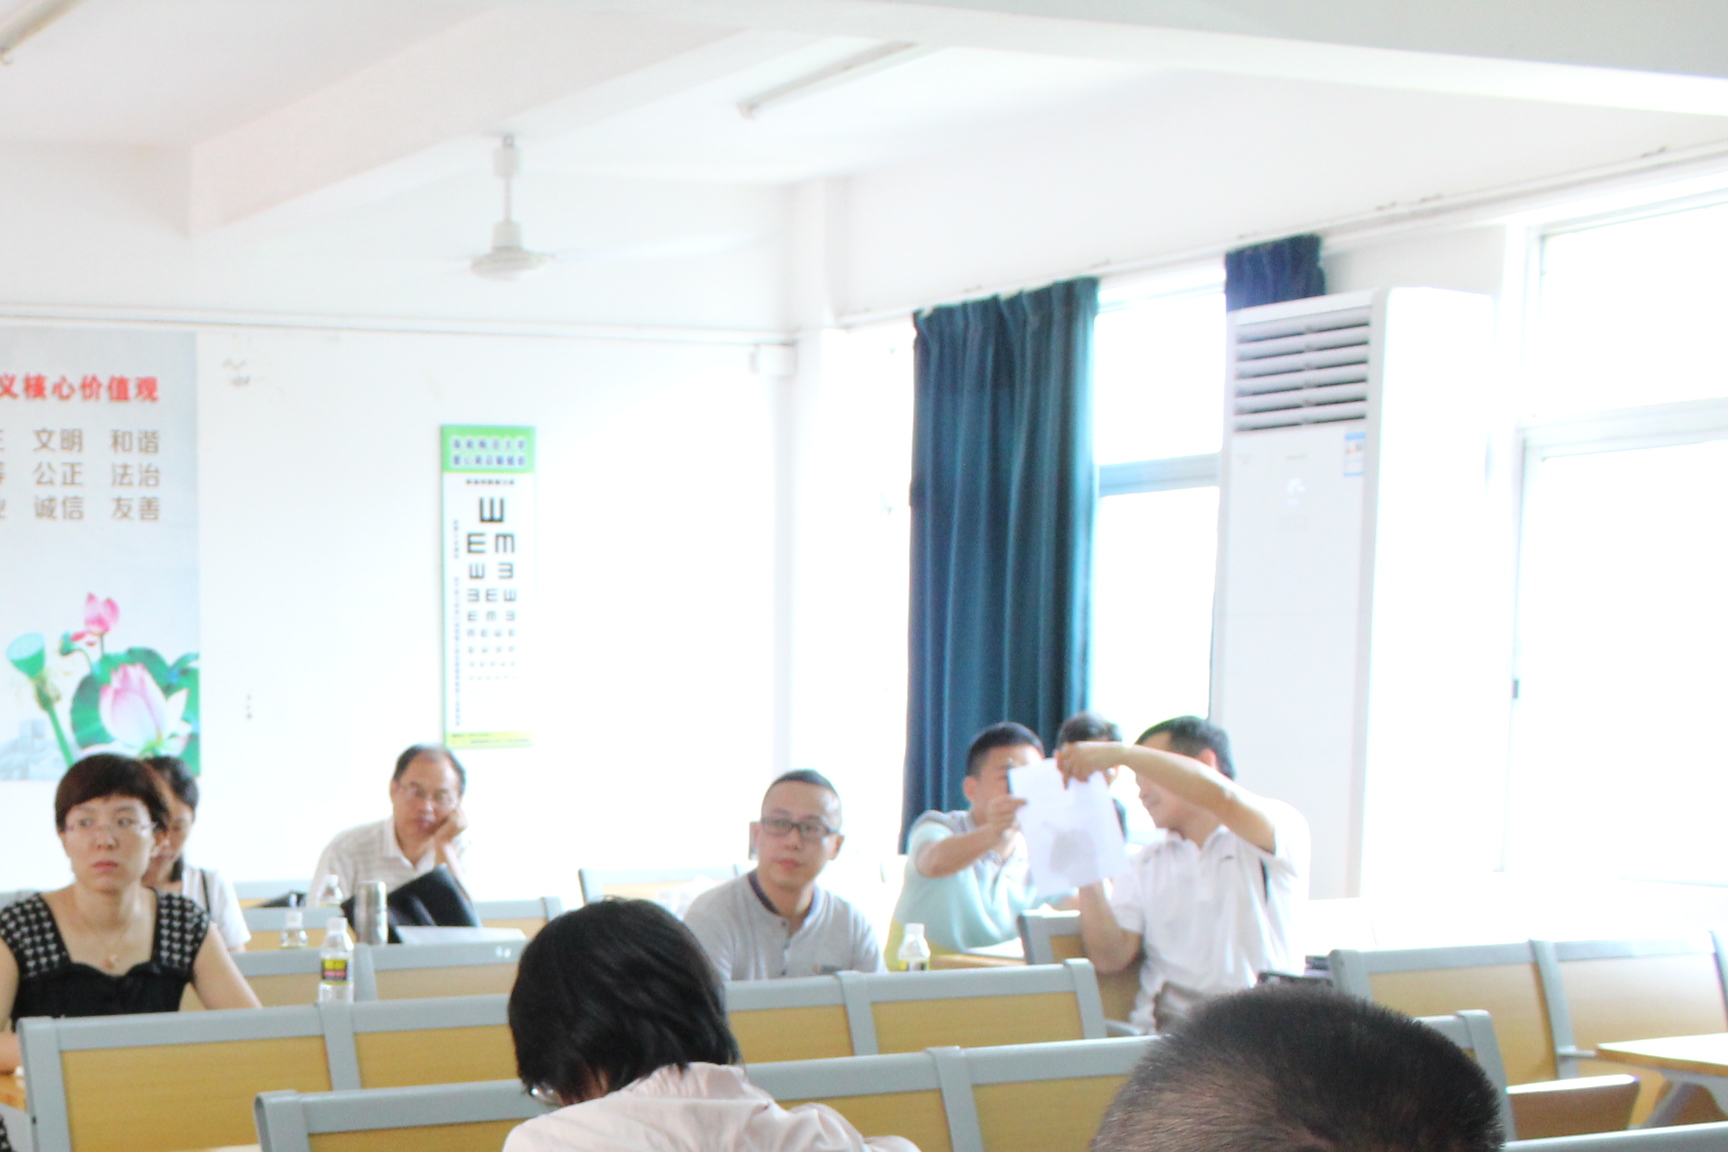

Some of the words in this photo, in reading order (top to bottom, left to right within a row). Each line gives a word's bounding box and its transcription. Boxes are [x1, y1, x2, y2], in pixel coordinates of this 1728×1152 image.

[33, 428, 84, 453] 文明
[111, 429, 160, 454] 和谐
[33, 462, 84, 487] 公正
[111, 463, 160, 488] 法治
[34, 496, 84, 521] 诚信
[112, 496, 160, 521] 友善
